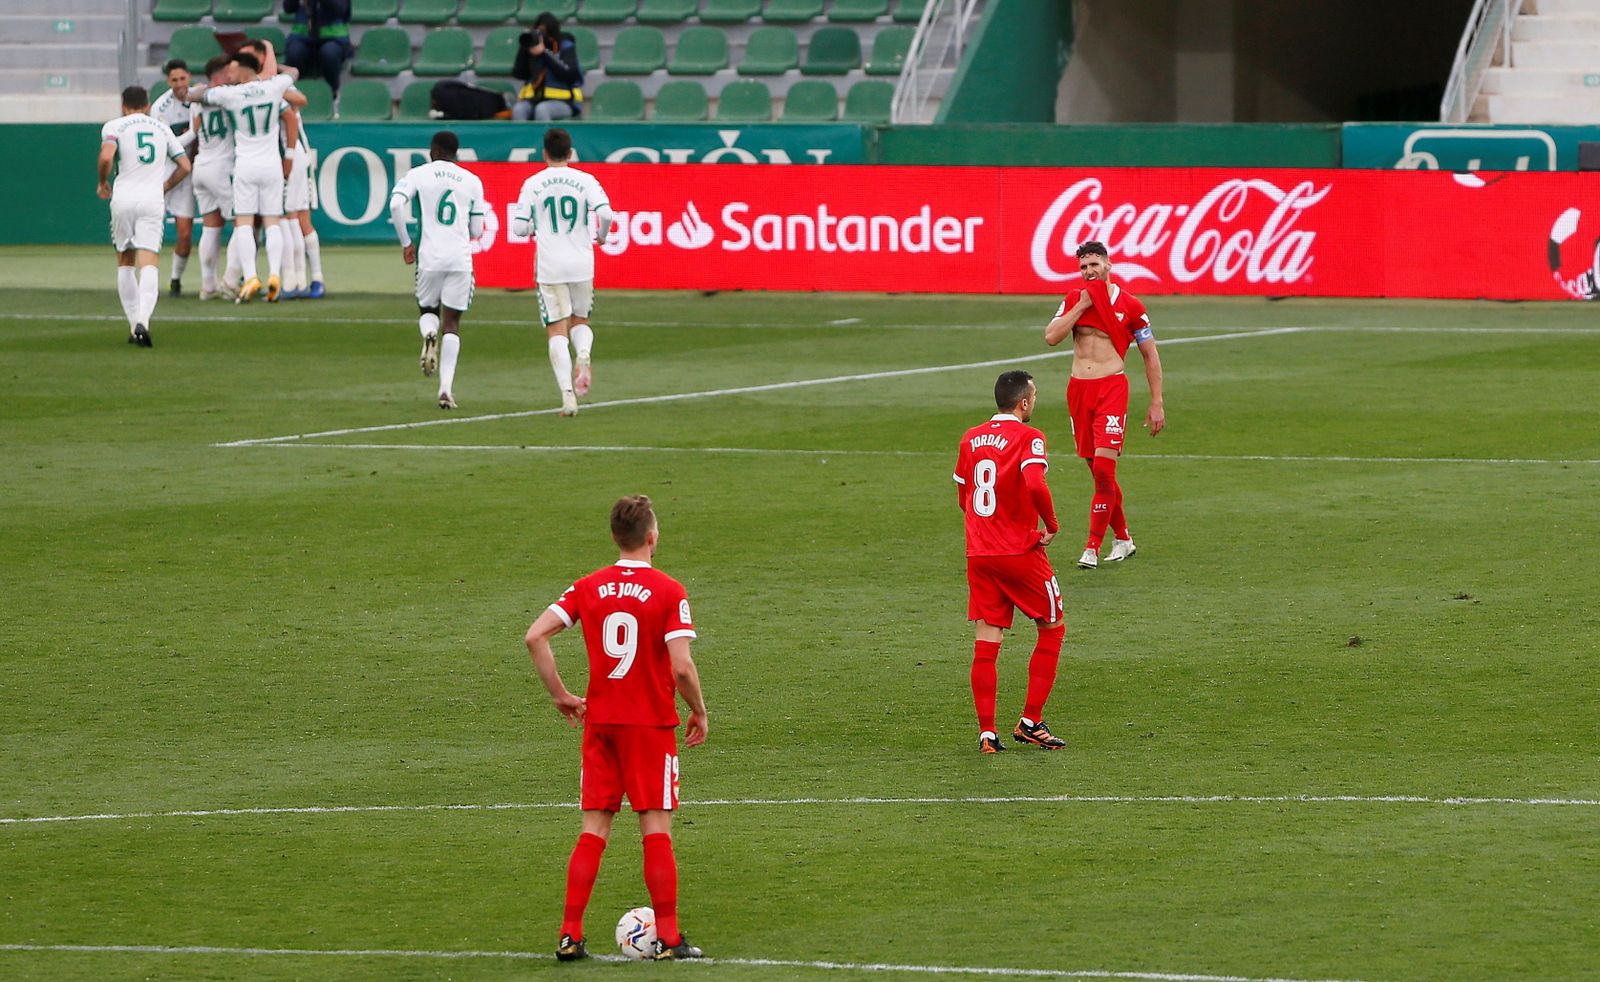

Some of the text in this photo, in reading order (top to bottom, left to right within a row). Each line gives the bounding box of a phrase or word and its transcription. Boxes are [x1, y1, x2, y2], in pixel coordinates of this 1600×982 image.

[241, 102, 273, 136] 17
[137, 132, 155, 164] 5
[437, 189, 457, 226] 6
[543, 195, 578, 235] 19
[721, 202, 984, 253] Santander
[969, 433, 1009, 453] JORDÁN
[972, 458, 997, 518] 8
[598, 582, 652, 603] DE JONG
[602, 611, 639, 679] 9
